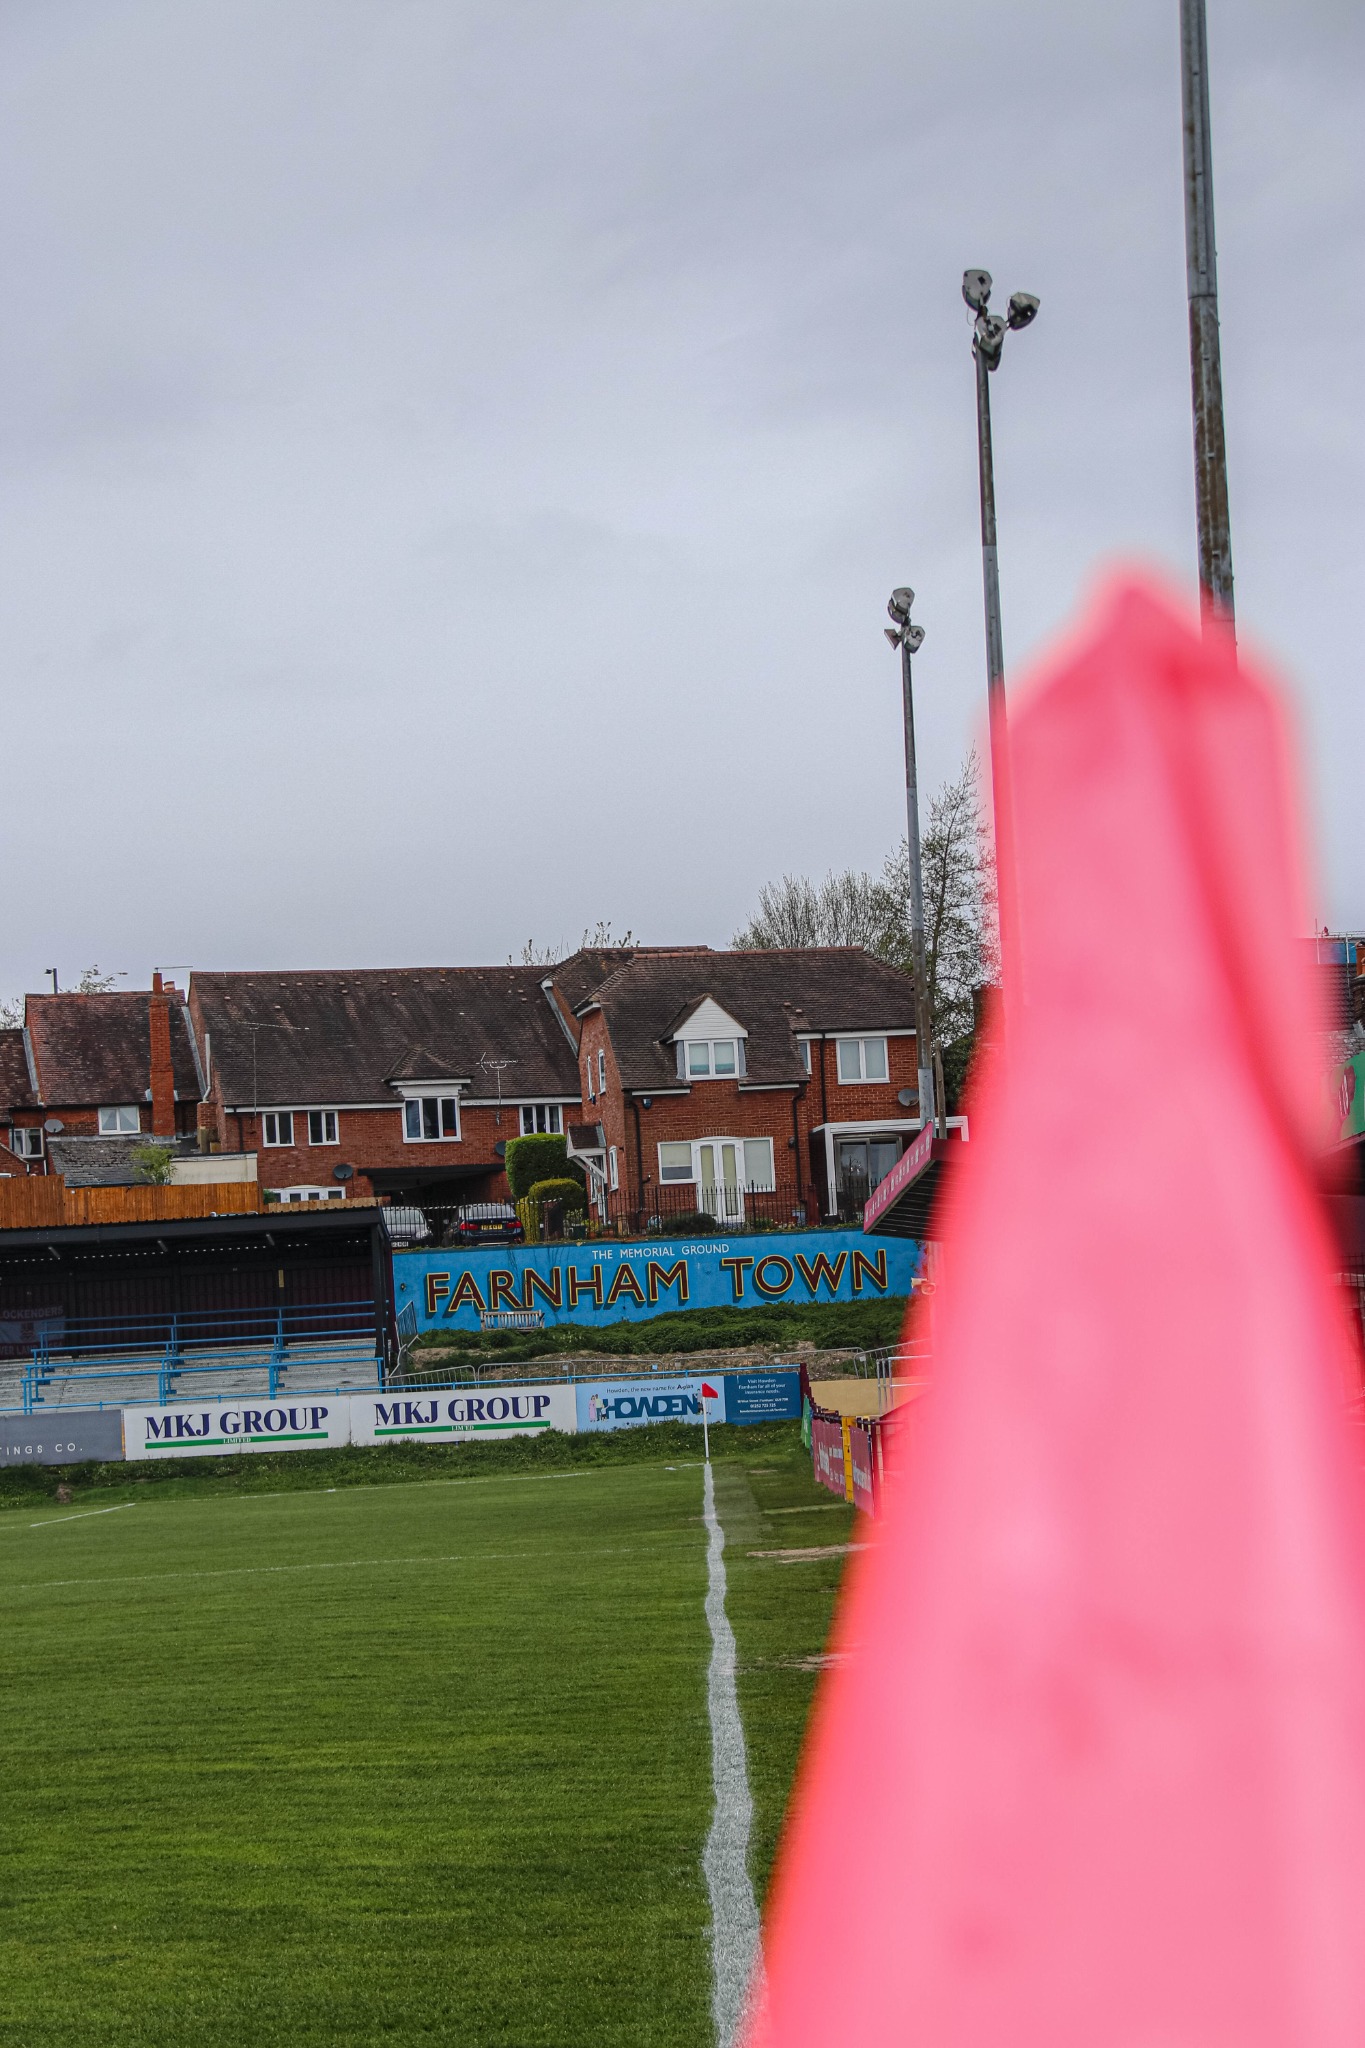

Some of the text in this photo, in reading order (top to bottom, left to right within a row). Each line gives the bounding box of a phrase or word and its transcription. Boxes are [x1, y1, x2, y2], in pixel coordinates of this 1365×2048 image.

[592, 1243, 729, 1260] THE MEMORIAL GROUND
[426, 1248, 888, 1313] FARNHAM TOWN
[0, 1305, 64, 1319] OCKENDERS
[373, 1395, 550, 1426] MKJ GROUP
[602, 1394, 699, 1419] HOWDEN
[144, 1406, 329, 1440] MKJ GROUP
[0, 1442, 83, 1456] INGS CO.
